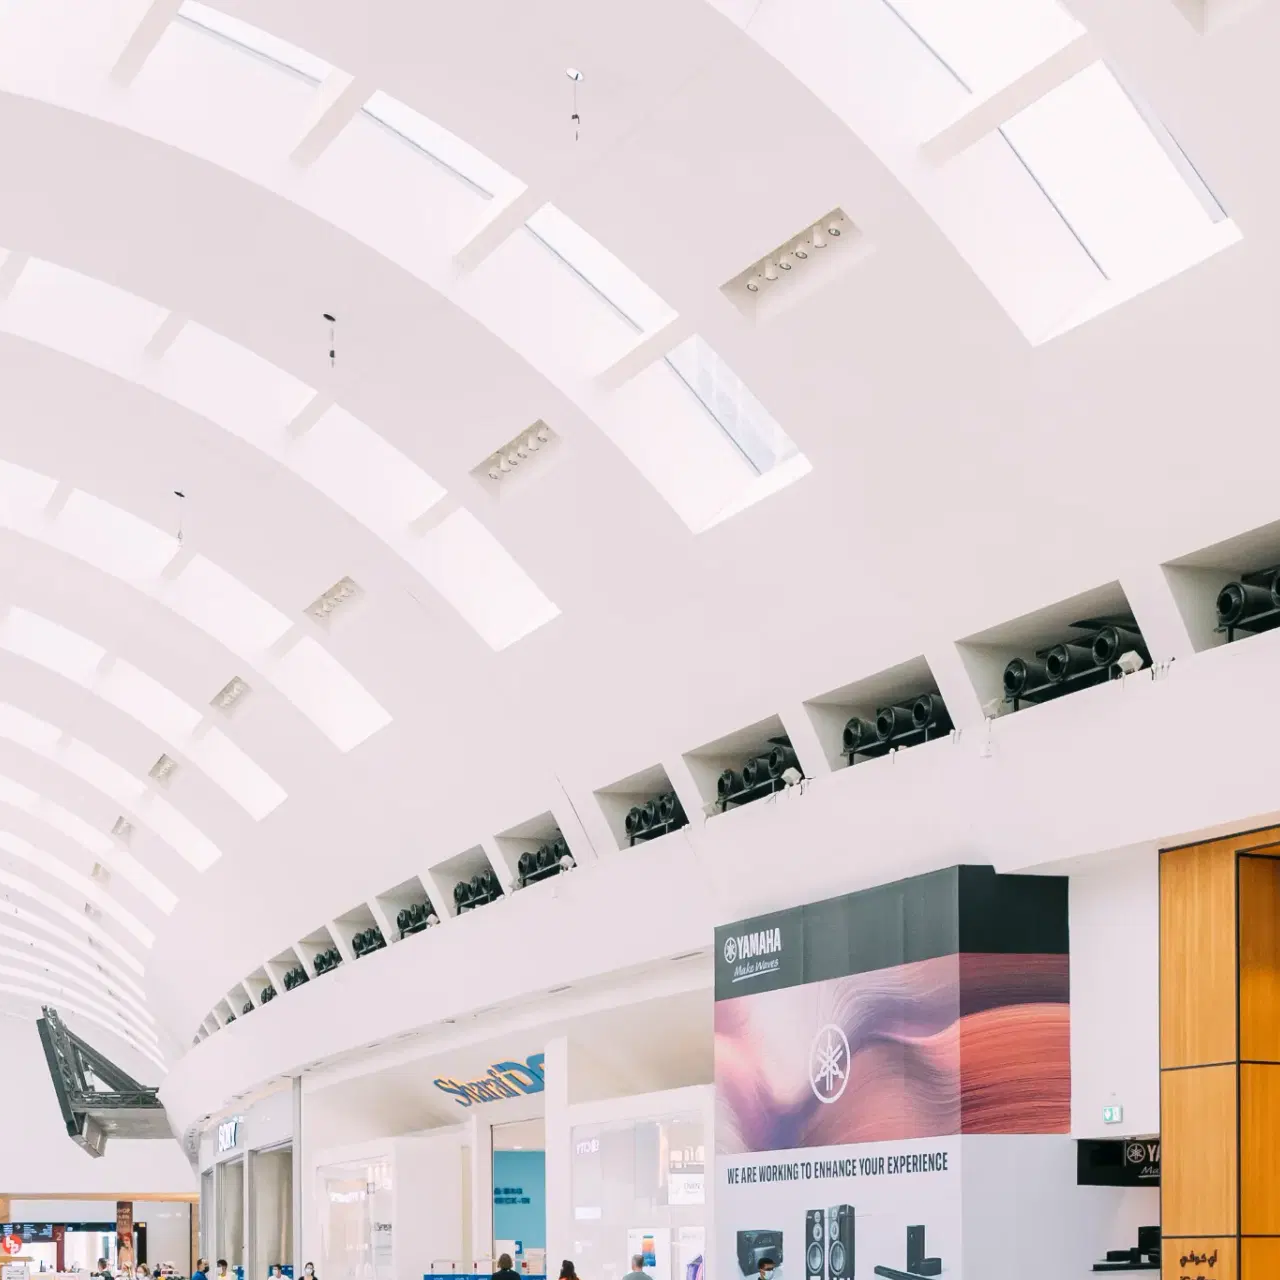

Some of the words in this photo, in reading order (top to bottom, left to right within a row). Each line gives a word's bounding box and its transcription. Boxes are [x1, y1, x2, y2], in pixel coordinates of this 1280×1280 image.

[737, 927, 782, 960] YAMAHA
[733, 962, 755, 977] Make
[755, 958, 779, 972] Waves
[433, 1069, 521, 1107] Sharaf
[727, 1166, 739, 1185] WE
[740, 1165, 757, 1184] ARE
[758, 1162, 799, 1183] WORKING
[800, 1161, 812, 1180] TO
[813, 1158, 857, 1179] ENHANCE
[859, 1156, 885, 1176] YOUR
[887, 1151, 949, 1175] EXPERIENCE
